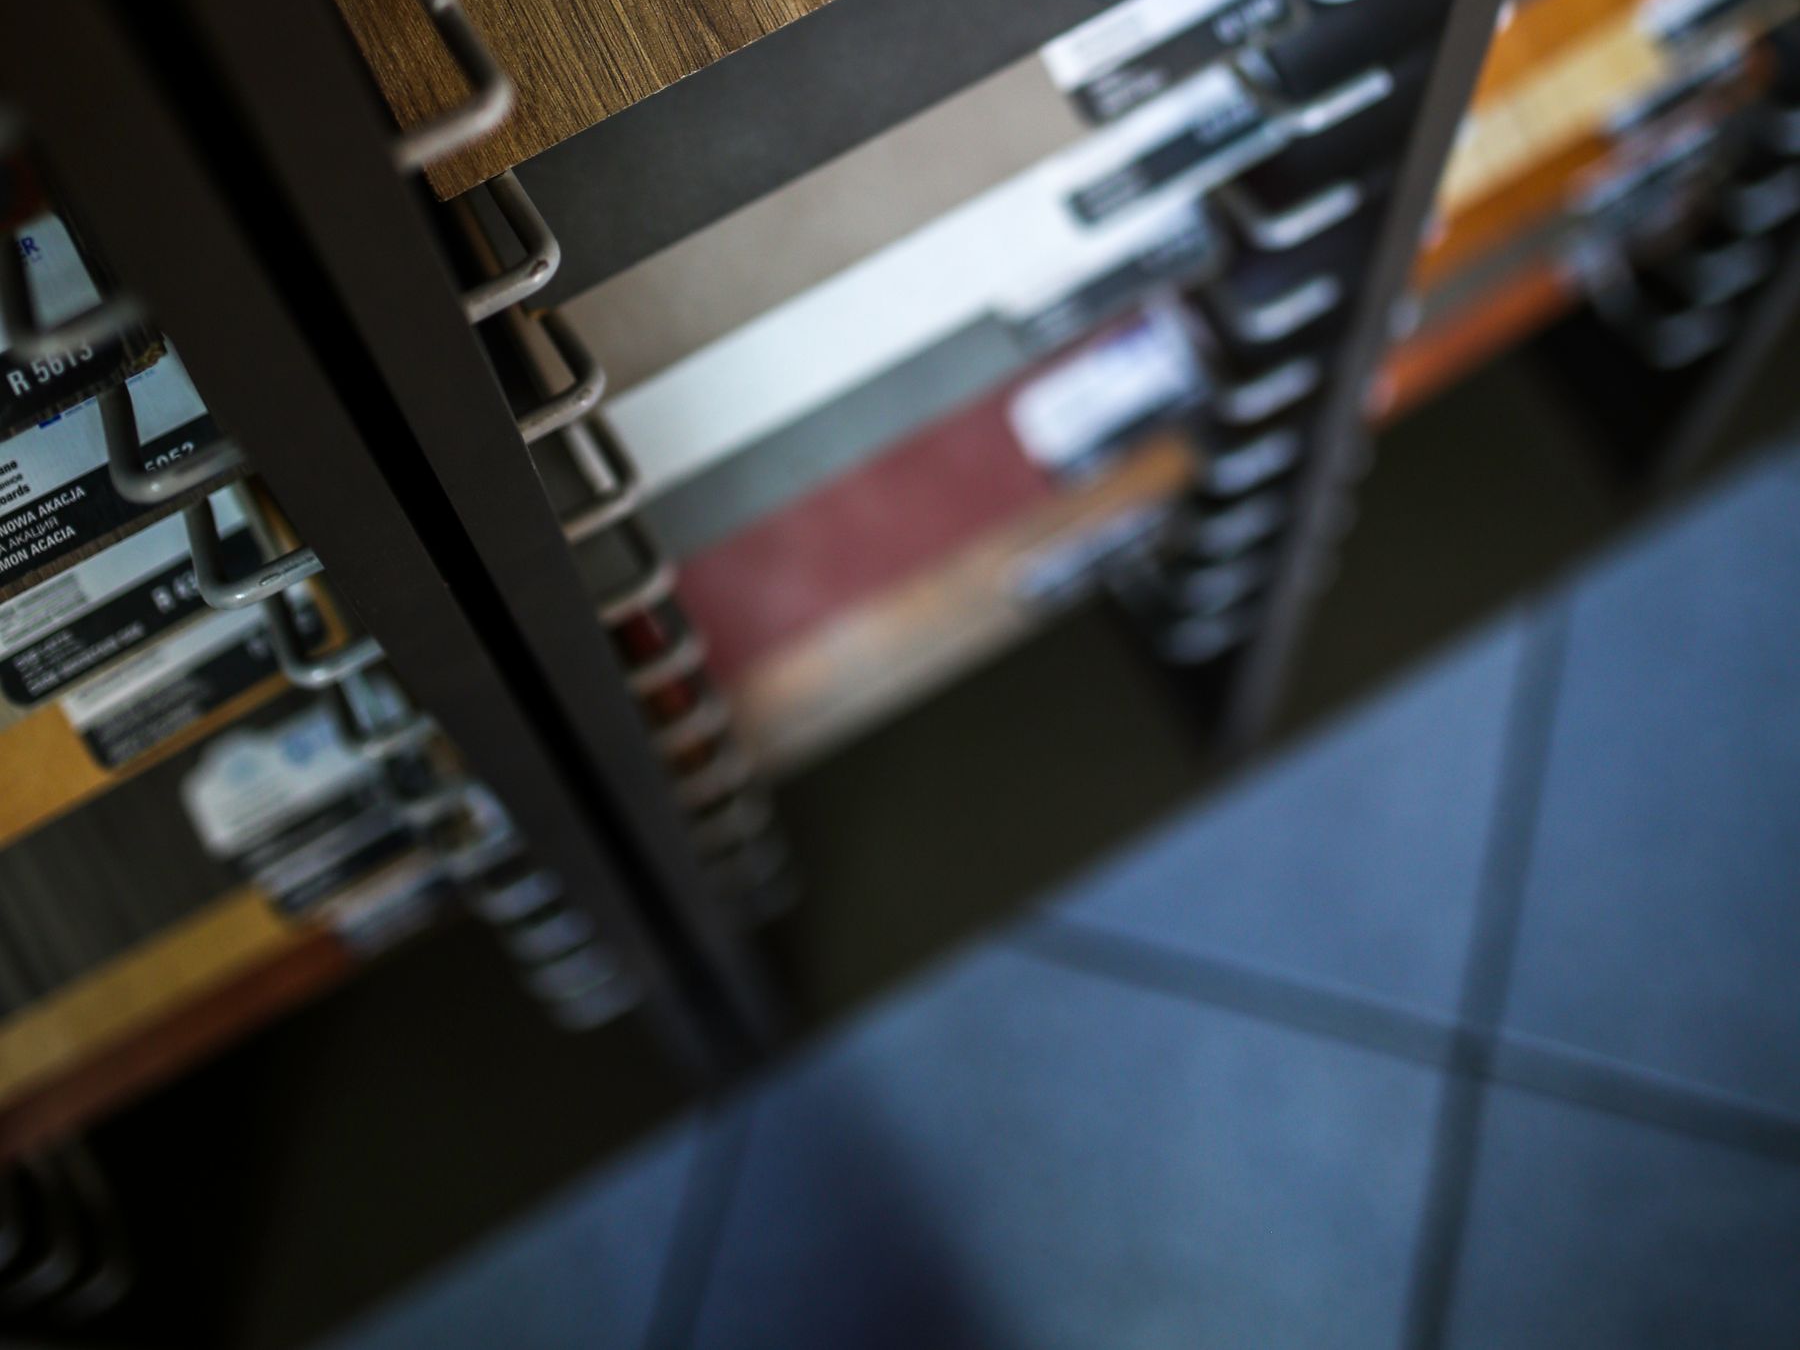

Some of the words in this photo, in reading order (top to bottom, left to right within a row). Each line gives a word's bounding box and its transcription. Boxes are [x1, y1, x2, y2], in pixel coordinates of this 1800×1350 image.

[5, 369, 31, 400] R
[37, 484, 87, 519] AKACJA
[30, 524, 78, 557] ACACIA
